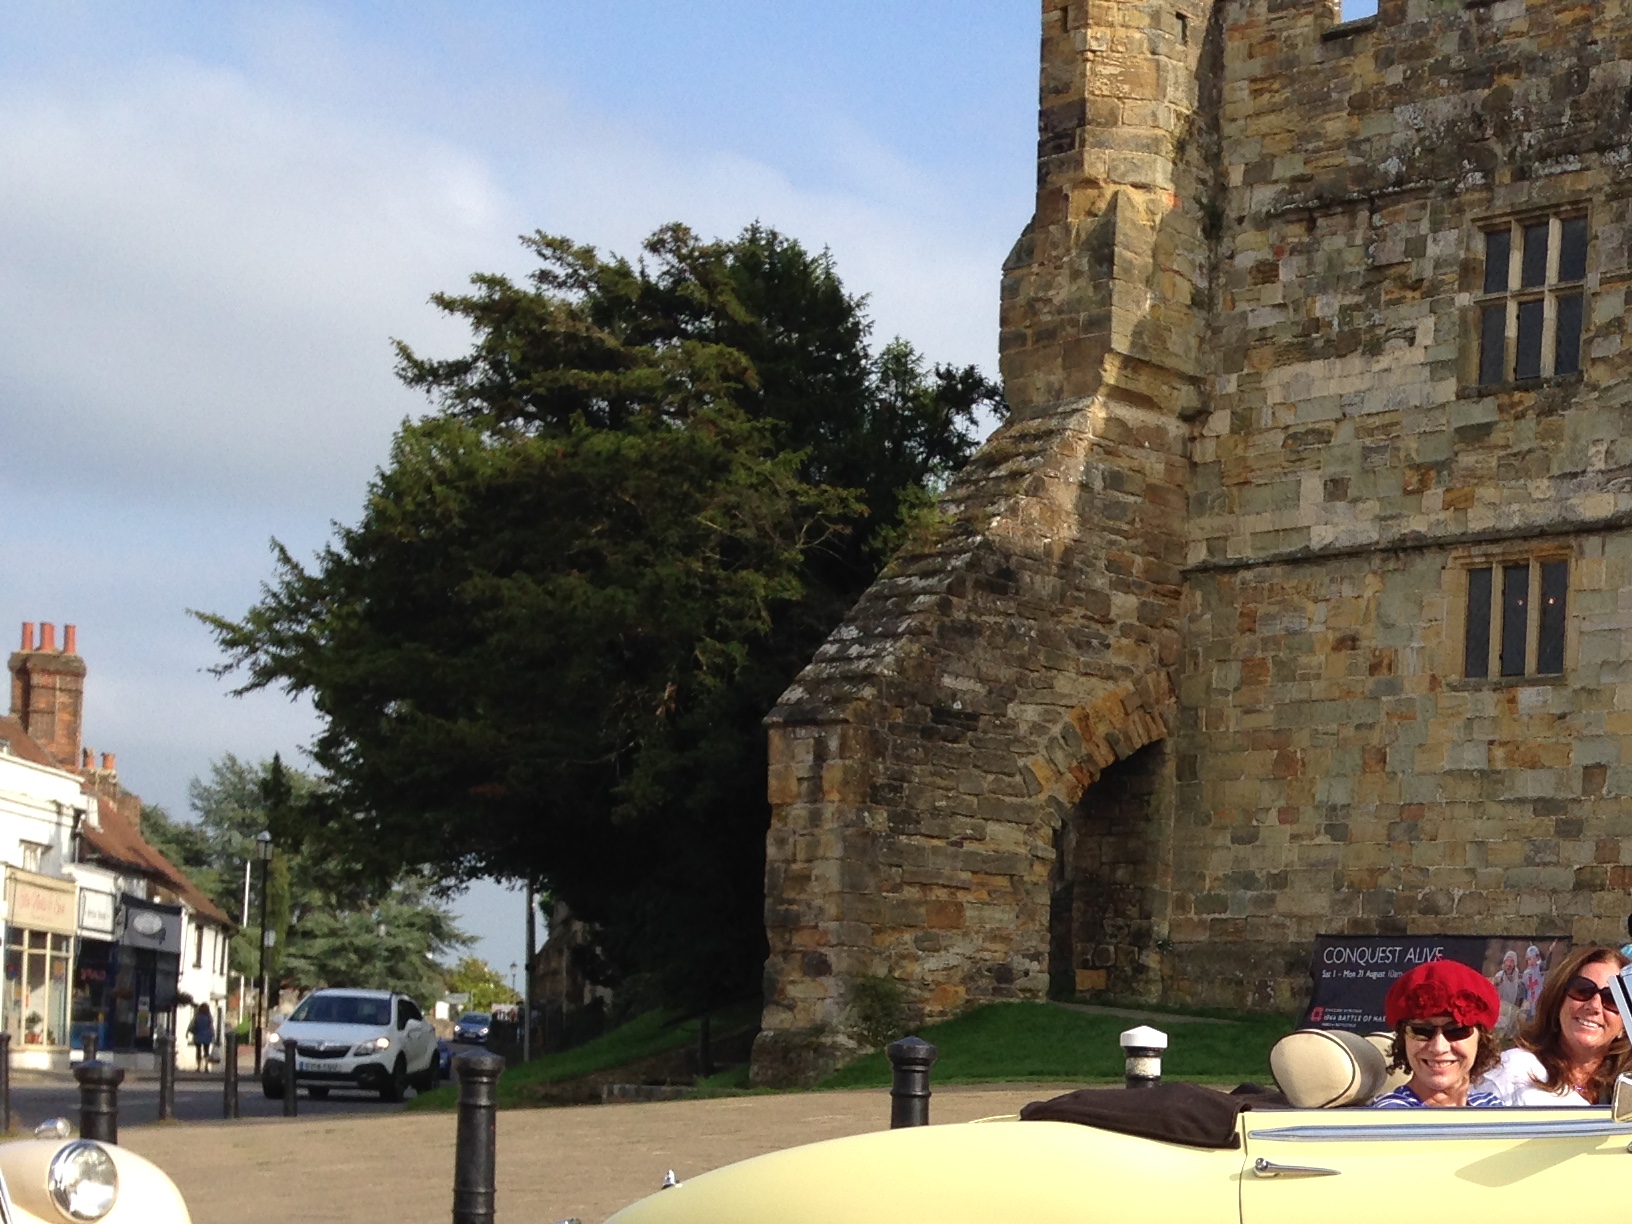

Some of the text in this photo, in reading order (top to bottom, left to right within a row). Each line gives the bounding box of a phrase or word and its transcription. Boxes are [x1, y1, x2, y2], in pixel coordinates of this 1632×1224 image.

[1323, 946, 1444, 966] CONQUEST ALIVE
[1322, 969, 1332, 978] Sat
[1343, 969, 1356, 978] Mon
[1365, 969, 1386, 980] August
[1338, 1014, 1361, 1022] BATTLE
